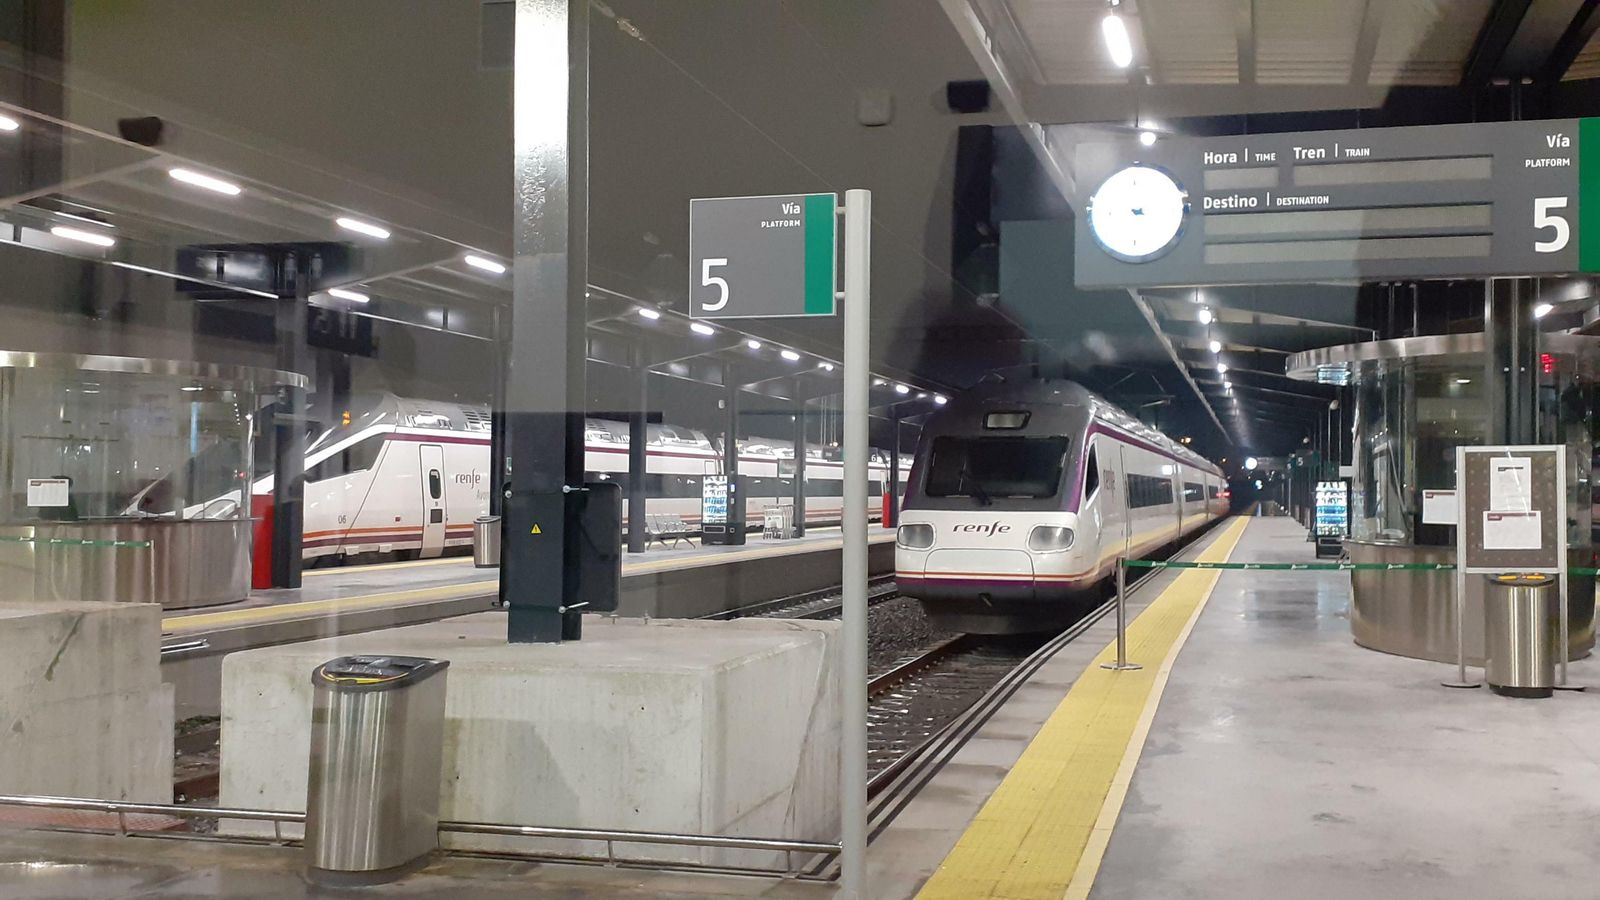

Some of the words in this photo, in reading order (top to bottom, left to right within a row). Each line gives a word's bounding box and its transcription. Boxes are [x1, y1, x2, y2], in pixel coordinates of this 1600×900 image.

[1546, 133, 1570, 148] Vía
[1203, 151, 1238, 165] Hora
[1254, 152, 1276, 162] TIME
[1292, 146, 1326, 160] Tren
[1344, 147, 1370, 157] TRAIN
[1525, 157, 1571, 168] PLATFORM
[781, 202, 801, 215] Vía
[1203, 194, 1258, 210] Destino
[1276, 195, 1329, 206] DESTINATION
[761, 219, 801, 228] PLATFORM
[1534, 196, 1570, 253] 5
[701, 258, 730, 312] 5
[871, 454, 877, 462] 6
[1297, 457, 1304, 466] 5
[455, 468, 481, 489] renfe
[953, 520, 1011, 537] renfe
